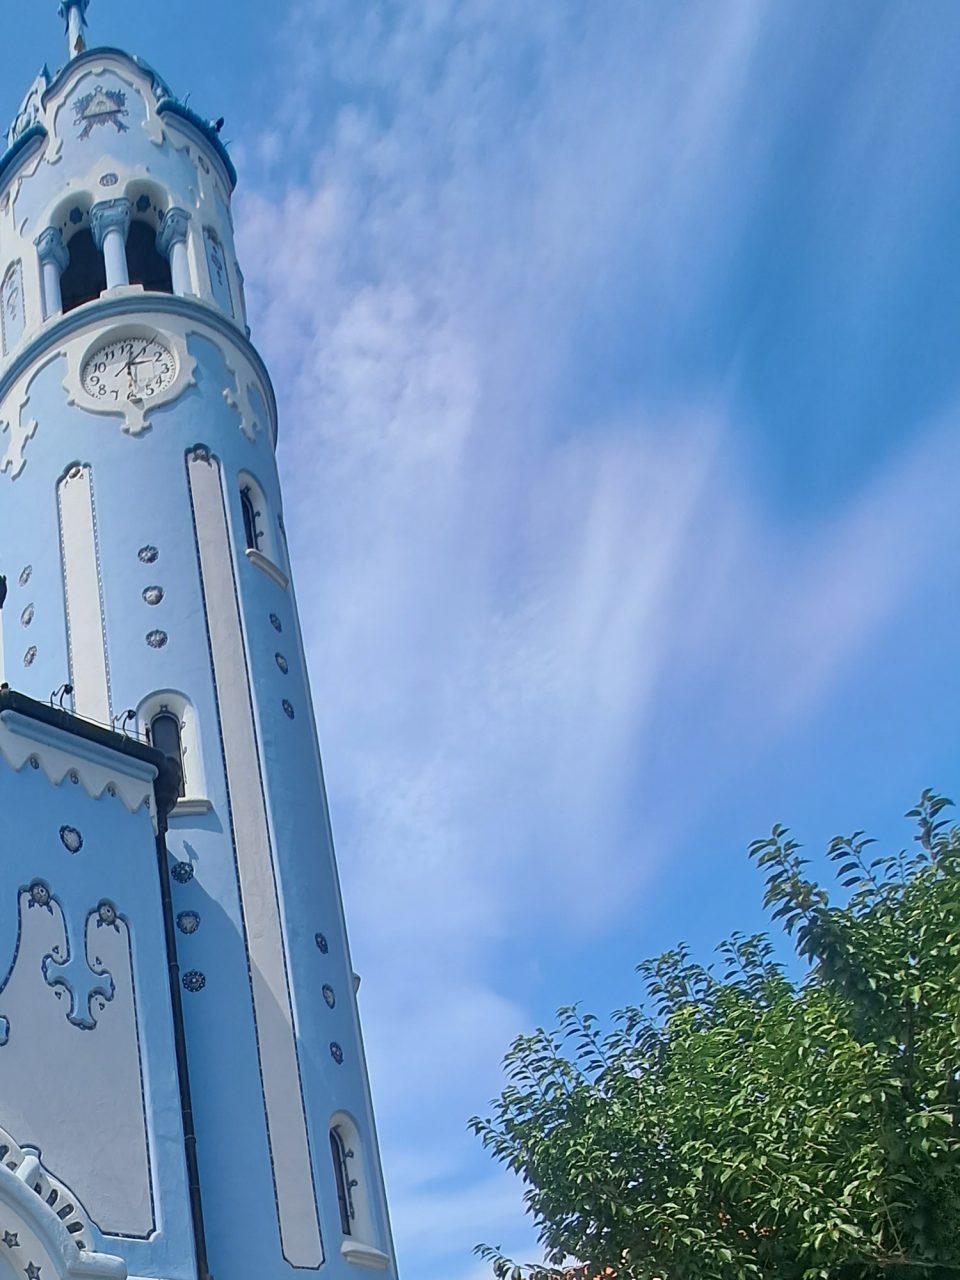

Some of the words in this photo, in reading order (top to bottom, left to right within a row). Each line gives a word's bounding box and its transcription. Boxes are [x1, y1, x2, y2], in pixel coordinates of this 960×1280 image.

[119, 343, 133, 355] 12
[104, 350, 115, 361] 11
[153, 351, 163, 362] 2
[93, 362, 107, 373] 10
[161, 363, 170, 374] 3
[90, 375, 100, 386] 9
[155, 375, 165, 388] 4
[98, 384, 107, 395] 8
[110, 389, 119, 400] 7
[145, 384, 154, 396] 5
